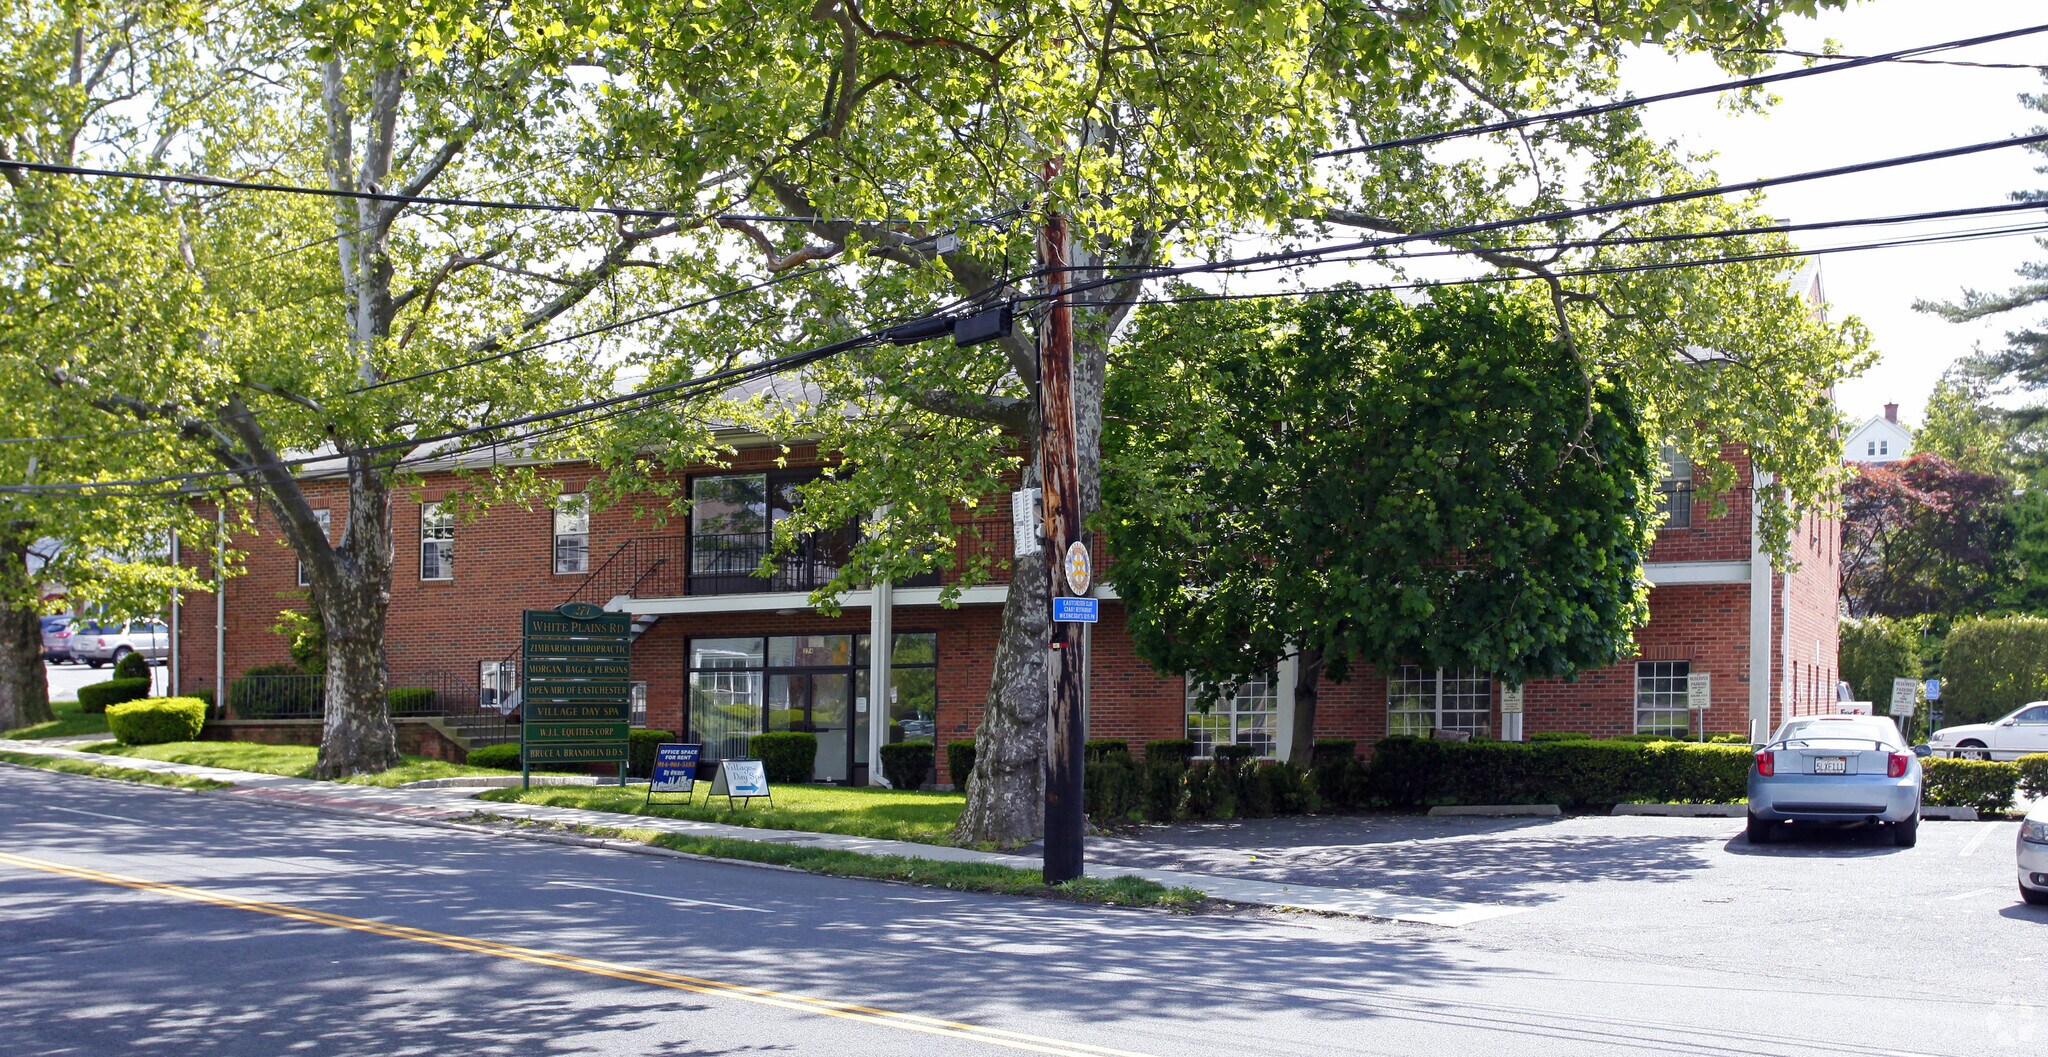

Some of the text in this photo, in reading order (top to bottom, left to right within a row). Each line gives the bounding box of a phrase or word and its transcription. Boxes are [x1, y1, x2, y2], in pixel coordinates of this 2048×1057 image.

[533, 621, 624, 633] WHITE PLAINS RD
[530, 644, 626, 654] ZIMBARDO CHIROPRACTIC
[587, 665, 593, 674] &
[594, 665, 628, 674] PERSONS
[528, 686, 627, 694] OPEN MRI OF EASTCHESTER
[537, 707, 619, 716] VILLAGE DAY SPA
[561, 728, 594, 737] EQUITIES
[530, 749, 554, 758] BRUCE
[725, 763, 753, 775] Village
[733, 772, 764, 784] Day Spa
